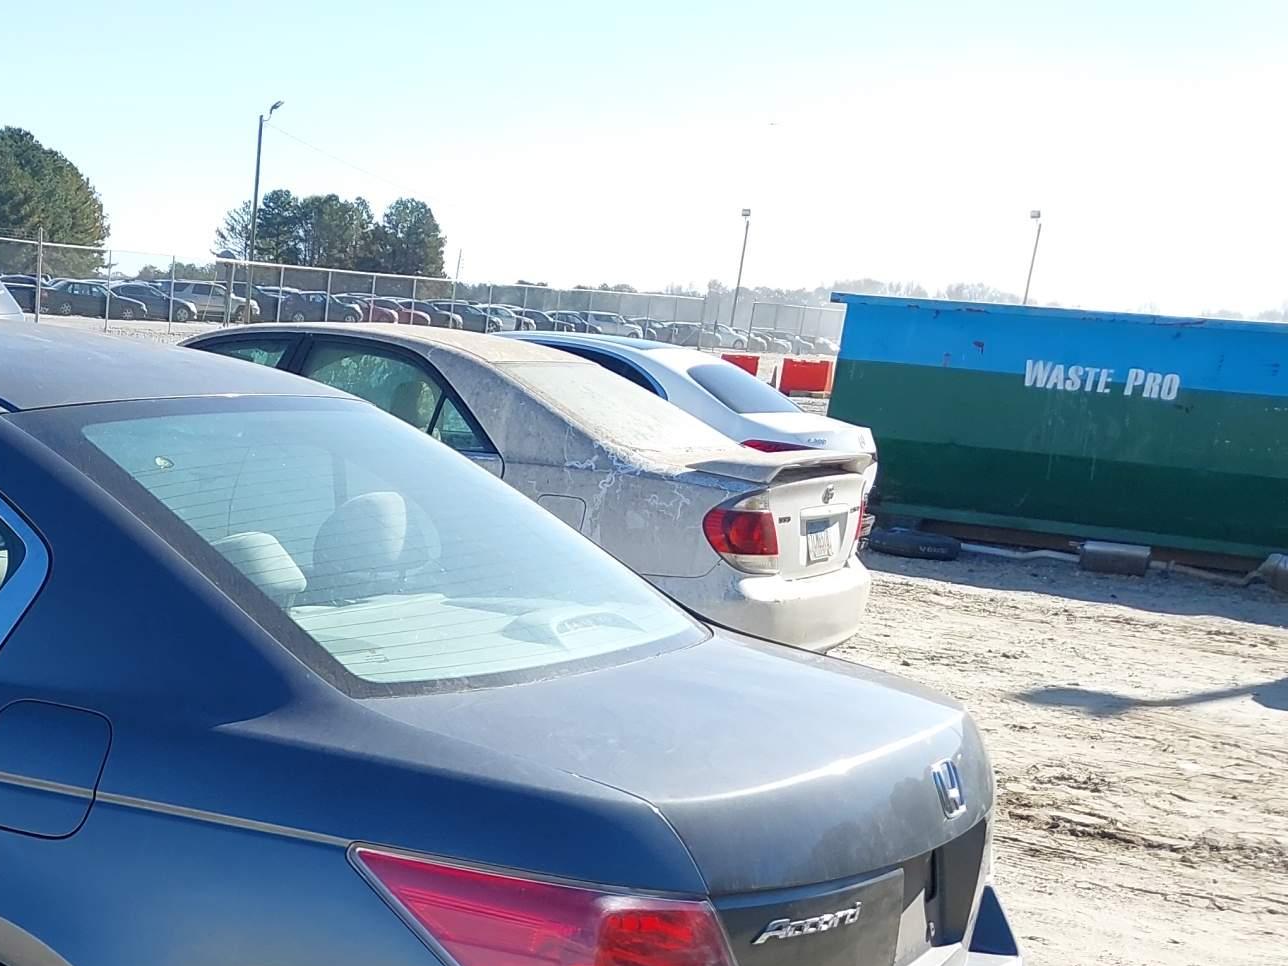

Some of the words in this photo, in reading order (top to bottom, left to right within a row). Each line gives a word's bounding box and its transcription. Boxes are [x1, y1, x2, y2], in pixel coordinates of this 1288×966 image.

[1024, 359, 1115, 393] WASTE
[1123, 368, 1181, 400] PRO
[751, 901, 862, 945] Accord
